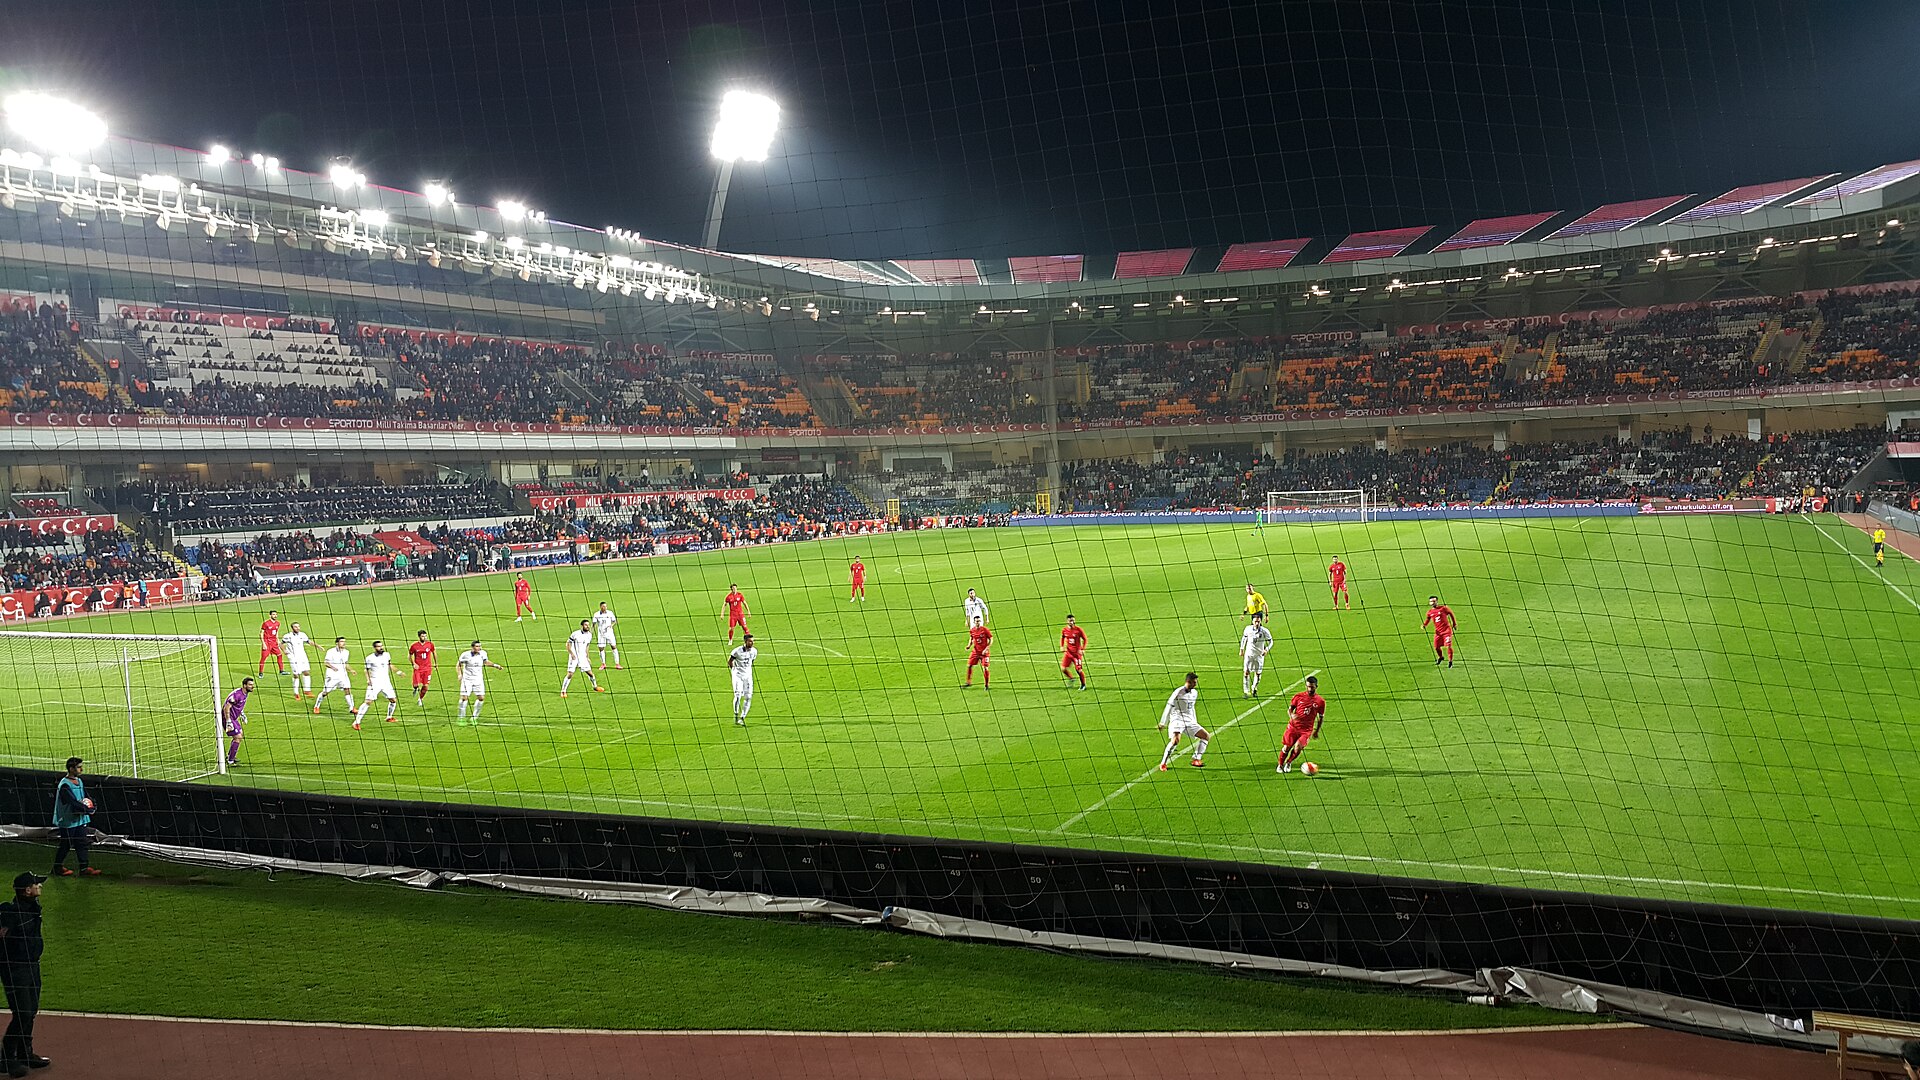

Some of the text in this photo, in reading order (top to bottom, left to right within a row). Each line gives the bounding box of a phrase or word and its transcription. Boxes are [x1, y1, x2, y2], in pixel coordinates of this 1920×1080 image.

[1484, 315, 1551, 330] SPOROTO
[1751, 386, 1778, 396] Takma
[138, 415, 247, 428] taraftarkulubu.tff.org
[1240, 413, 1285, 422] SPORTOTO
[329, 419, 374, 428] SPORTOTO
[376, 420, 392, 429] Milli
[693, 427, 723, 435] SPORTOTO
[950, 869, 961, 877] 49
[1030, 876, 1042, 884] 50
[1114, 884, 1126, 892] 51
[1203, 892, 1216, 900] 52
[1296, 901, 1309, 909] 53
[1395, 911, 1410, 920] 54
